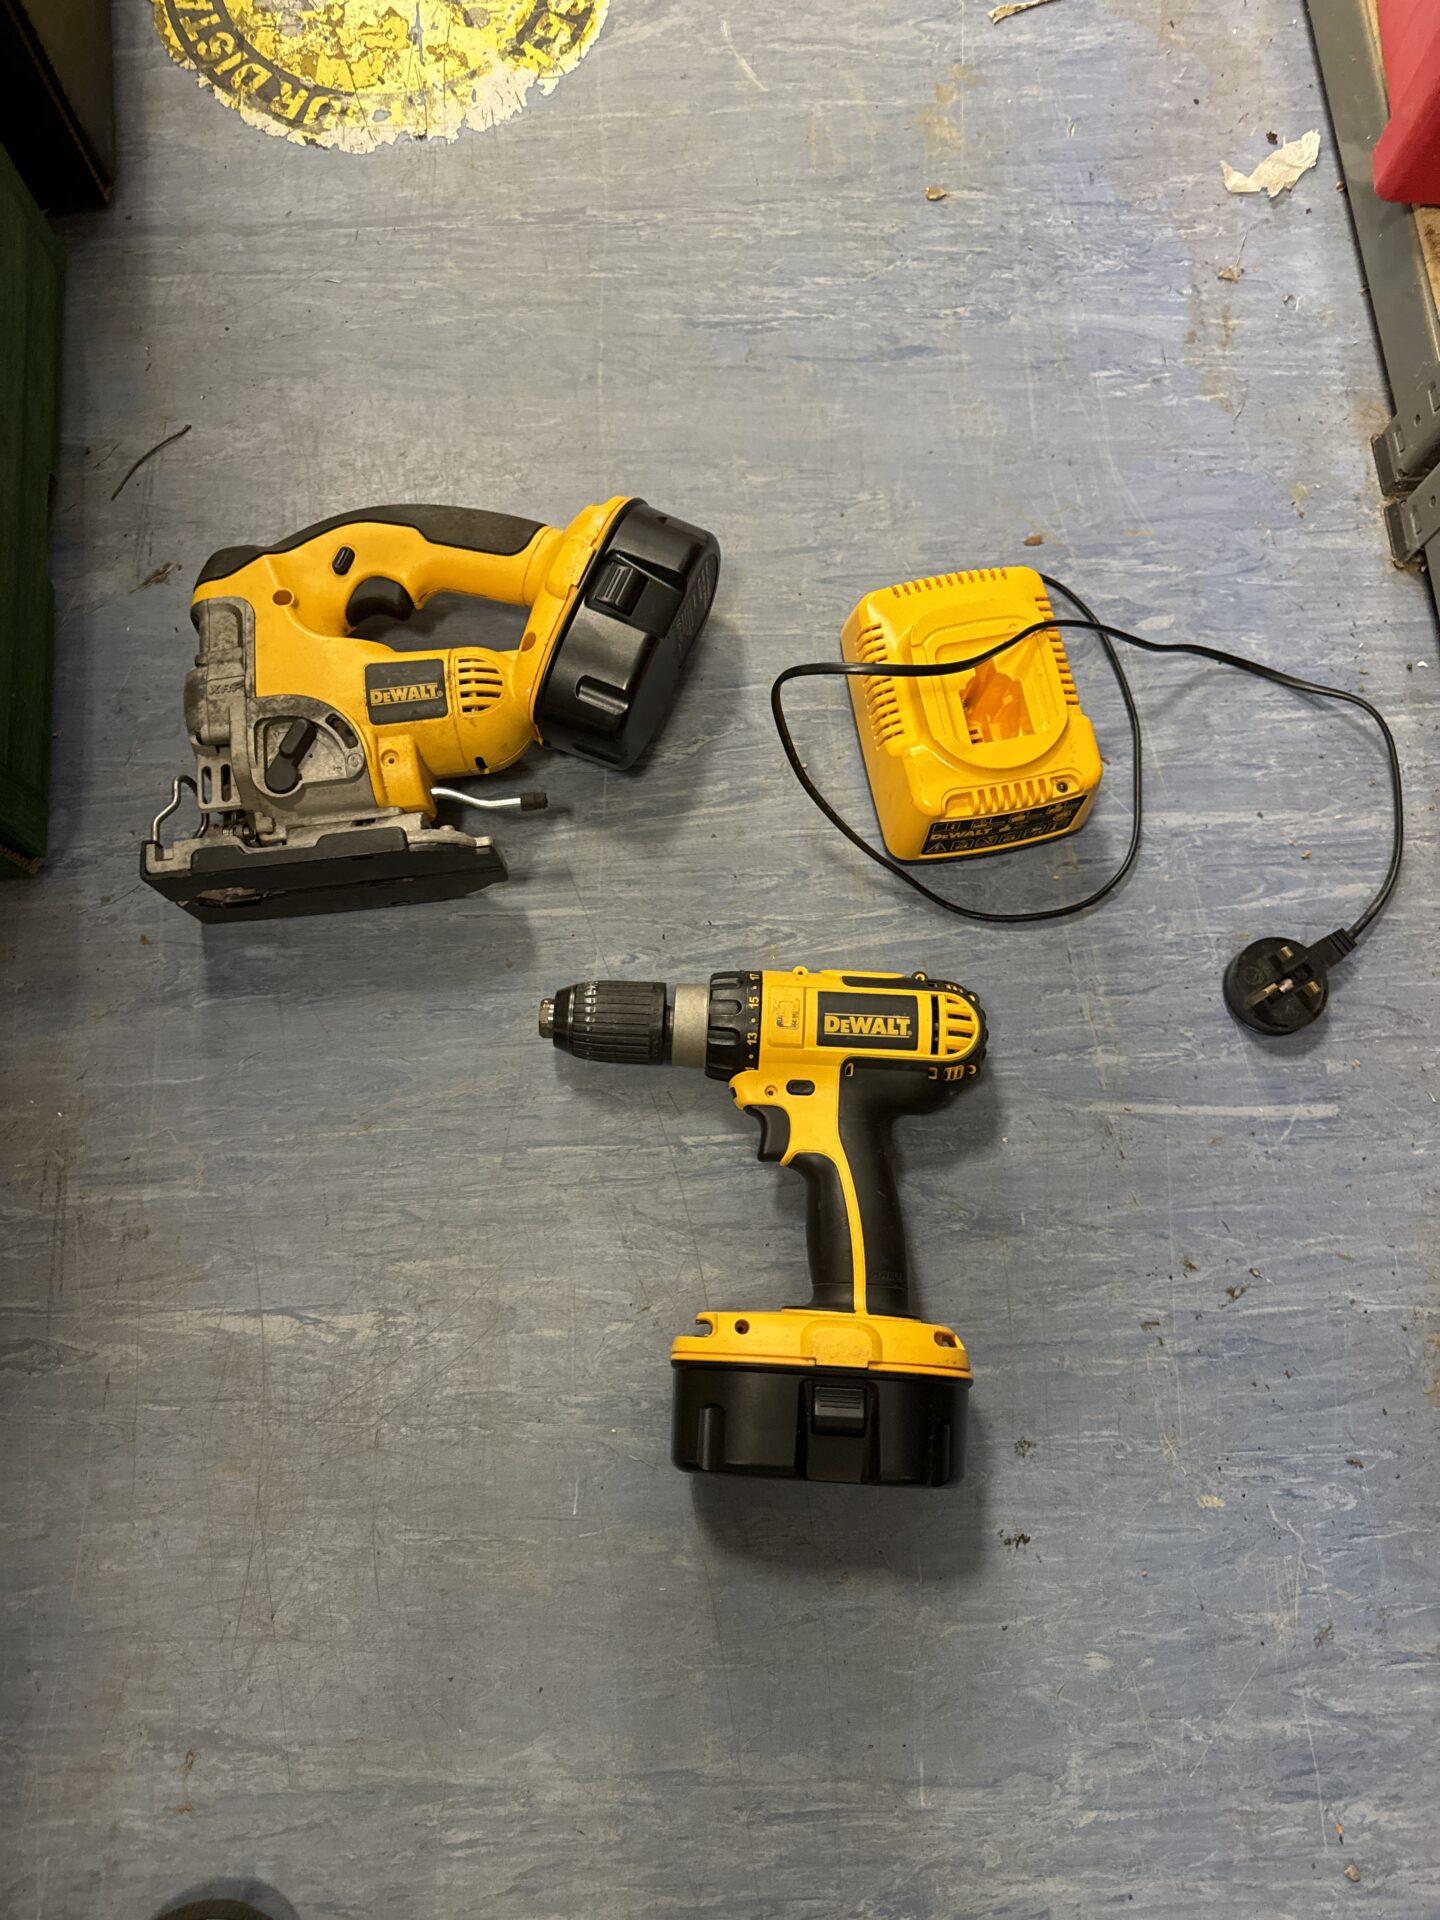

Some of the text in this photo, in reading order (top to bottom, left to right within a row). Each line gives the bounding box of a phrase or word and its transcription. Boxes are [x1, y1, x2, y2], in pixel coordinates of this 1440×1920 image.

[370, 684, 438, 705] DEWALT
[748, 996, 760, 1009] 15
[824, 1015, 910, 1036] DEWALT
[747, 1032, 758, 1045] 13
